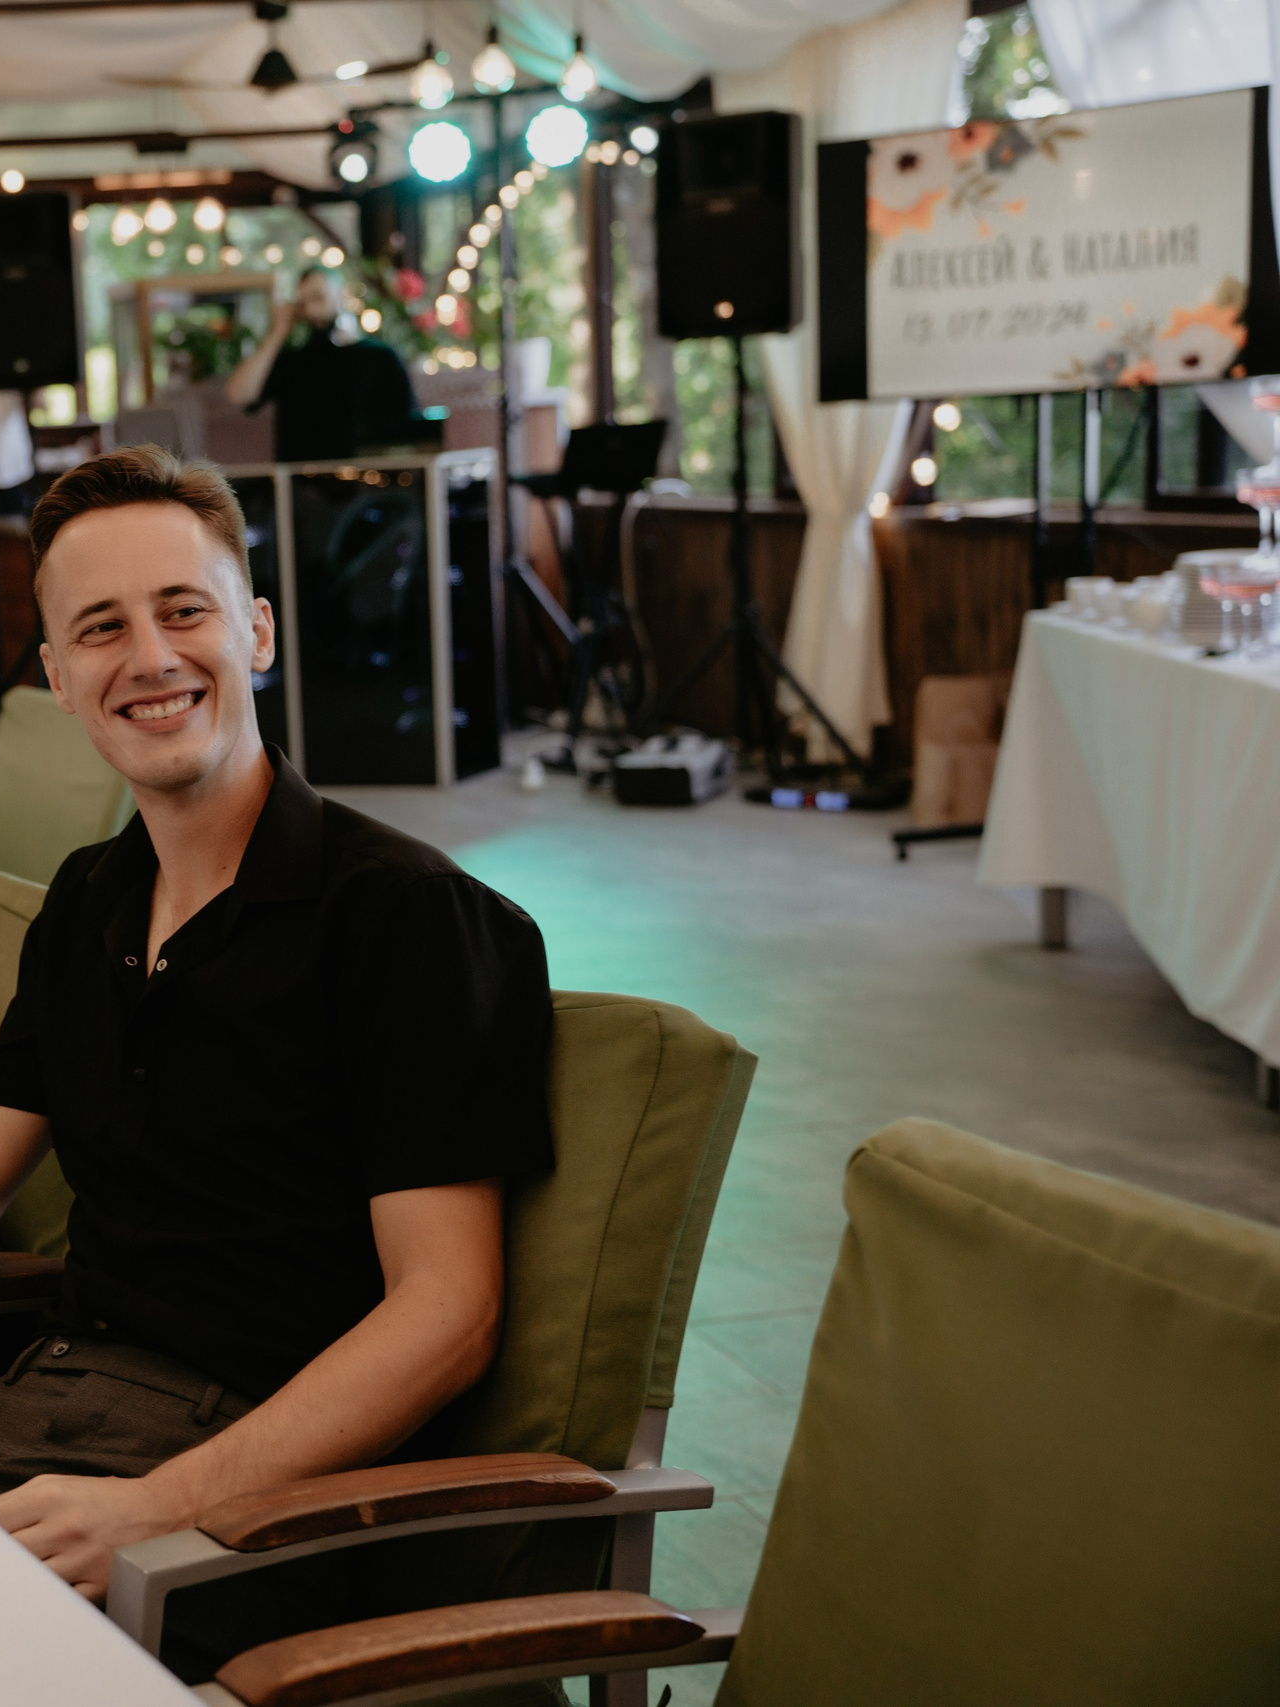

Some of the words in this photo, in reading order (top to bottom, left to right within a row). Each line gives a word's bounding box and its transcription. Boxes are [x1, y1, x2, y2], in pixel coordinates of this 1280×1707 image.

[891, 234, 1016, 289] АЛЕКСЕЙ
[1026, 233, 1052, 283] &
[1065, 224, 1198, 274] НАТАЛИЯ
